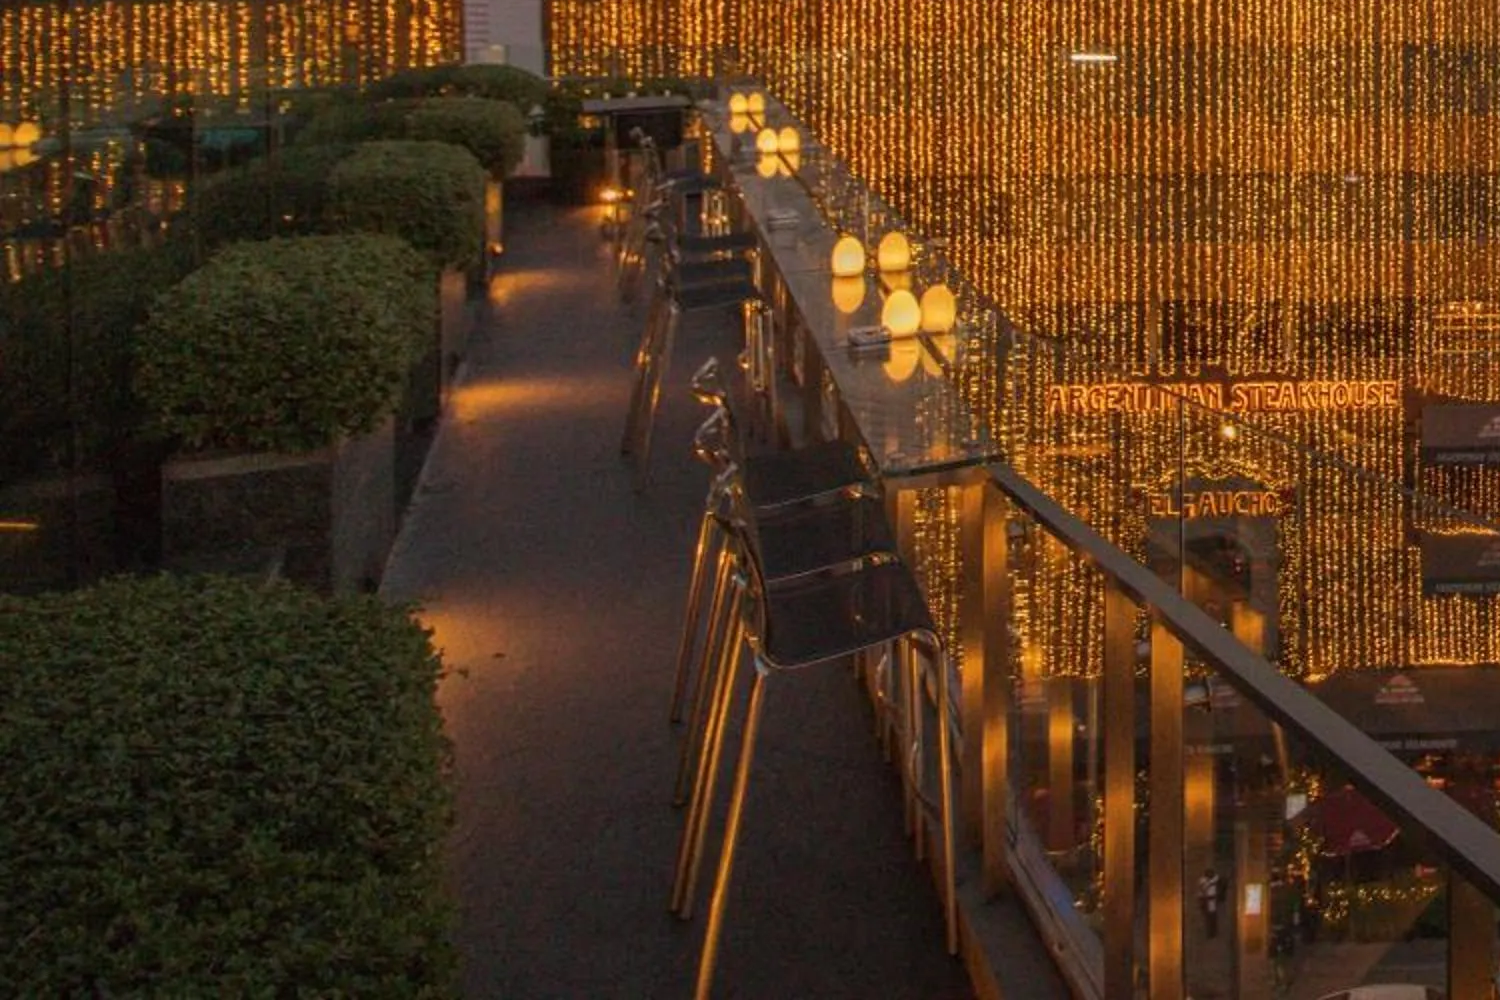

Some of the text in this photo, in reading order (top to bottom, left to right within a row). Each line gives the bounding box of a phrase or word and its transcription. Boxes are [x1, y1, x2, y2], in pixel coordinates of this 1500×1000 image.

[1231, 381, 1399, 410] STEAKHOUSE
[1151, 491, 1277, 516] EL GAUCHO
